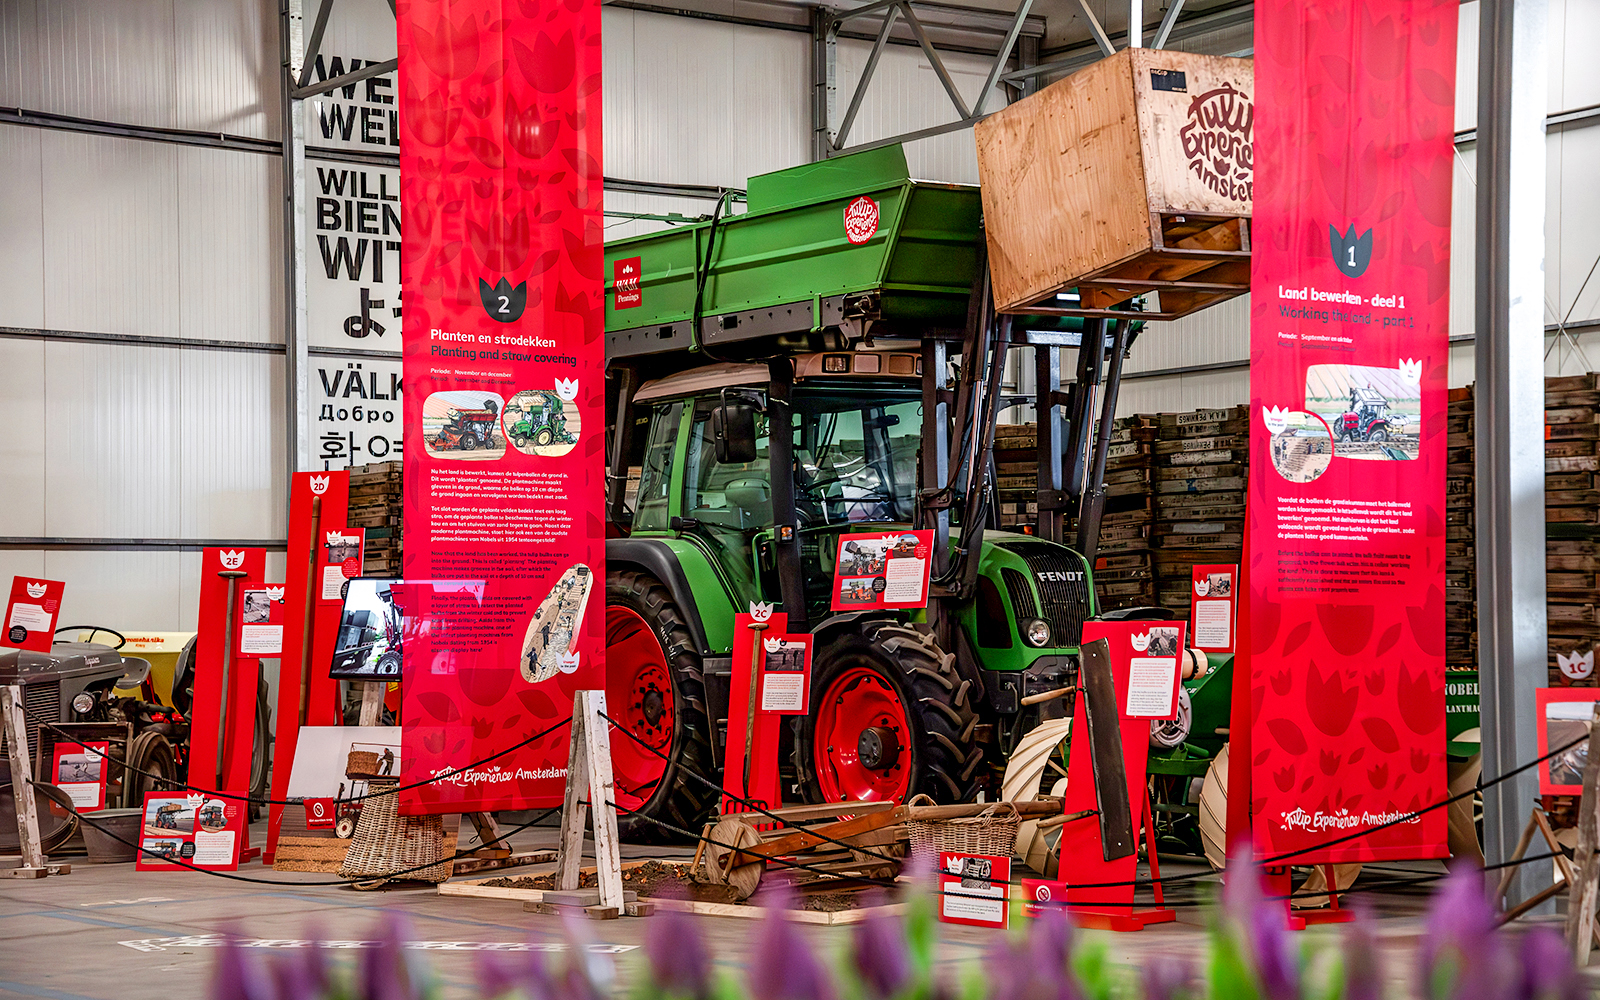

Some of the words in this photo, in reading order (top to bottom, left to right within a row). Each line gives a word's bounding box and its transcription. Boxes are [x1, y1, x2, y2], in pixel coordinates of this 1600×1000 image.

[848, 197, 873, 219] Tulip
[1347, 246, 1357, 268] 1
[498, 295, 510, 314] 2
[618, 293, 639, 303] Pennings
[1279, 285, 1307, 300] Land
[1371, 294, 1396, 308] deel
[1398, 296, 1405, 309] 1
[1279, 305, 1329, 324] Working
[1332, 309, 1348, 322] the
[1350, 311, 1371, 324] land
[1384, 316, 1406, 329] part
[1409, 317, 1414, 328] 1
[430, 328, 474, 342] Planten
[478, 334, 491, 344] en
[494, 334, 556, 347] strodekken
[1301, 334, 1330, 342] September
[432, 345, 476, 361] Planting
[479, 349, 499, 360] and
[502, 352, 531, 362] straw
[534, 353, 576, 368] covering
[318, 404, 394, 424] Добро
[314, 483, 325, 491] 2D
[226, 557, 238, 566] 2E
[1037, 571, 1083, 582] FENDT
[755, 610, 767, 618] 2C
[1569, 662, 1586, 674] 1C
[1446, 683, 1480, 696] OBEL
[464, 766, 513, 786] Experience
[515, 767, 568, 780] Amsterdam
[1285, 807, 1311, 830] Tulip
[1313, 808, 1360, 831] Experience
